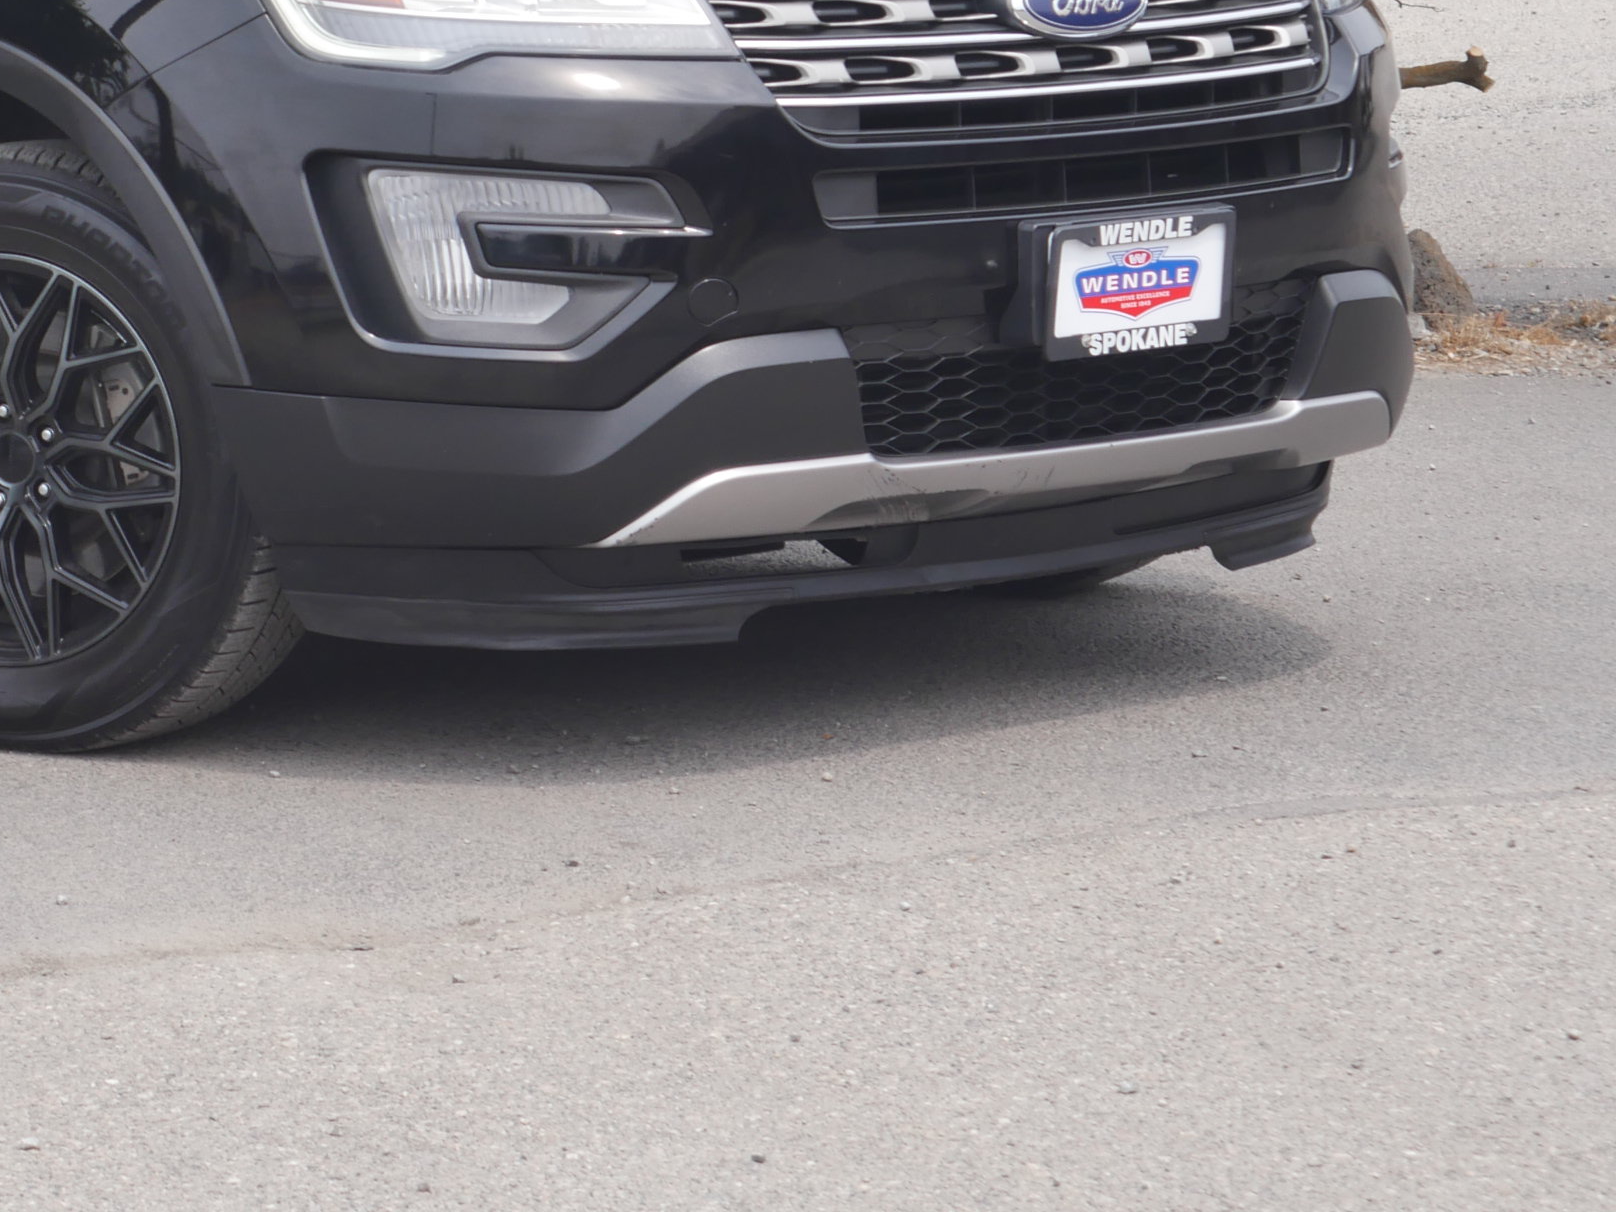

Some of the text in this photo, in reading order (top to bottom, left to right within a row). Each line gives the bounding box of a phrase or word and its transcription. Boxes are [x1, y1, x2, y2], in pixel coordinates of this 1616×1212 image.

[1099, 215, 1194, 245] WENDLE
[1081, 267, 1190, 294] WENDLE
[1088, 323, 1188, 356] SPOKANE
